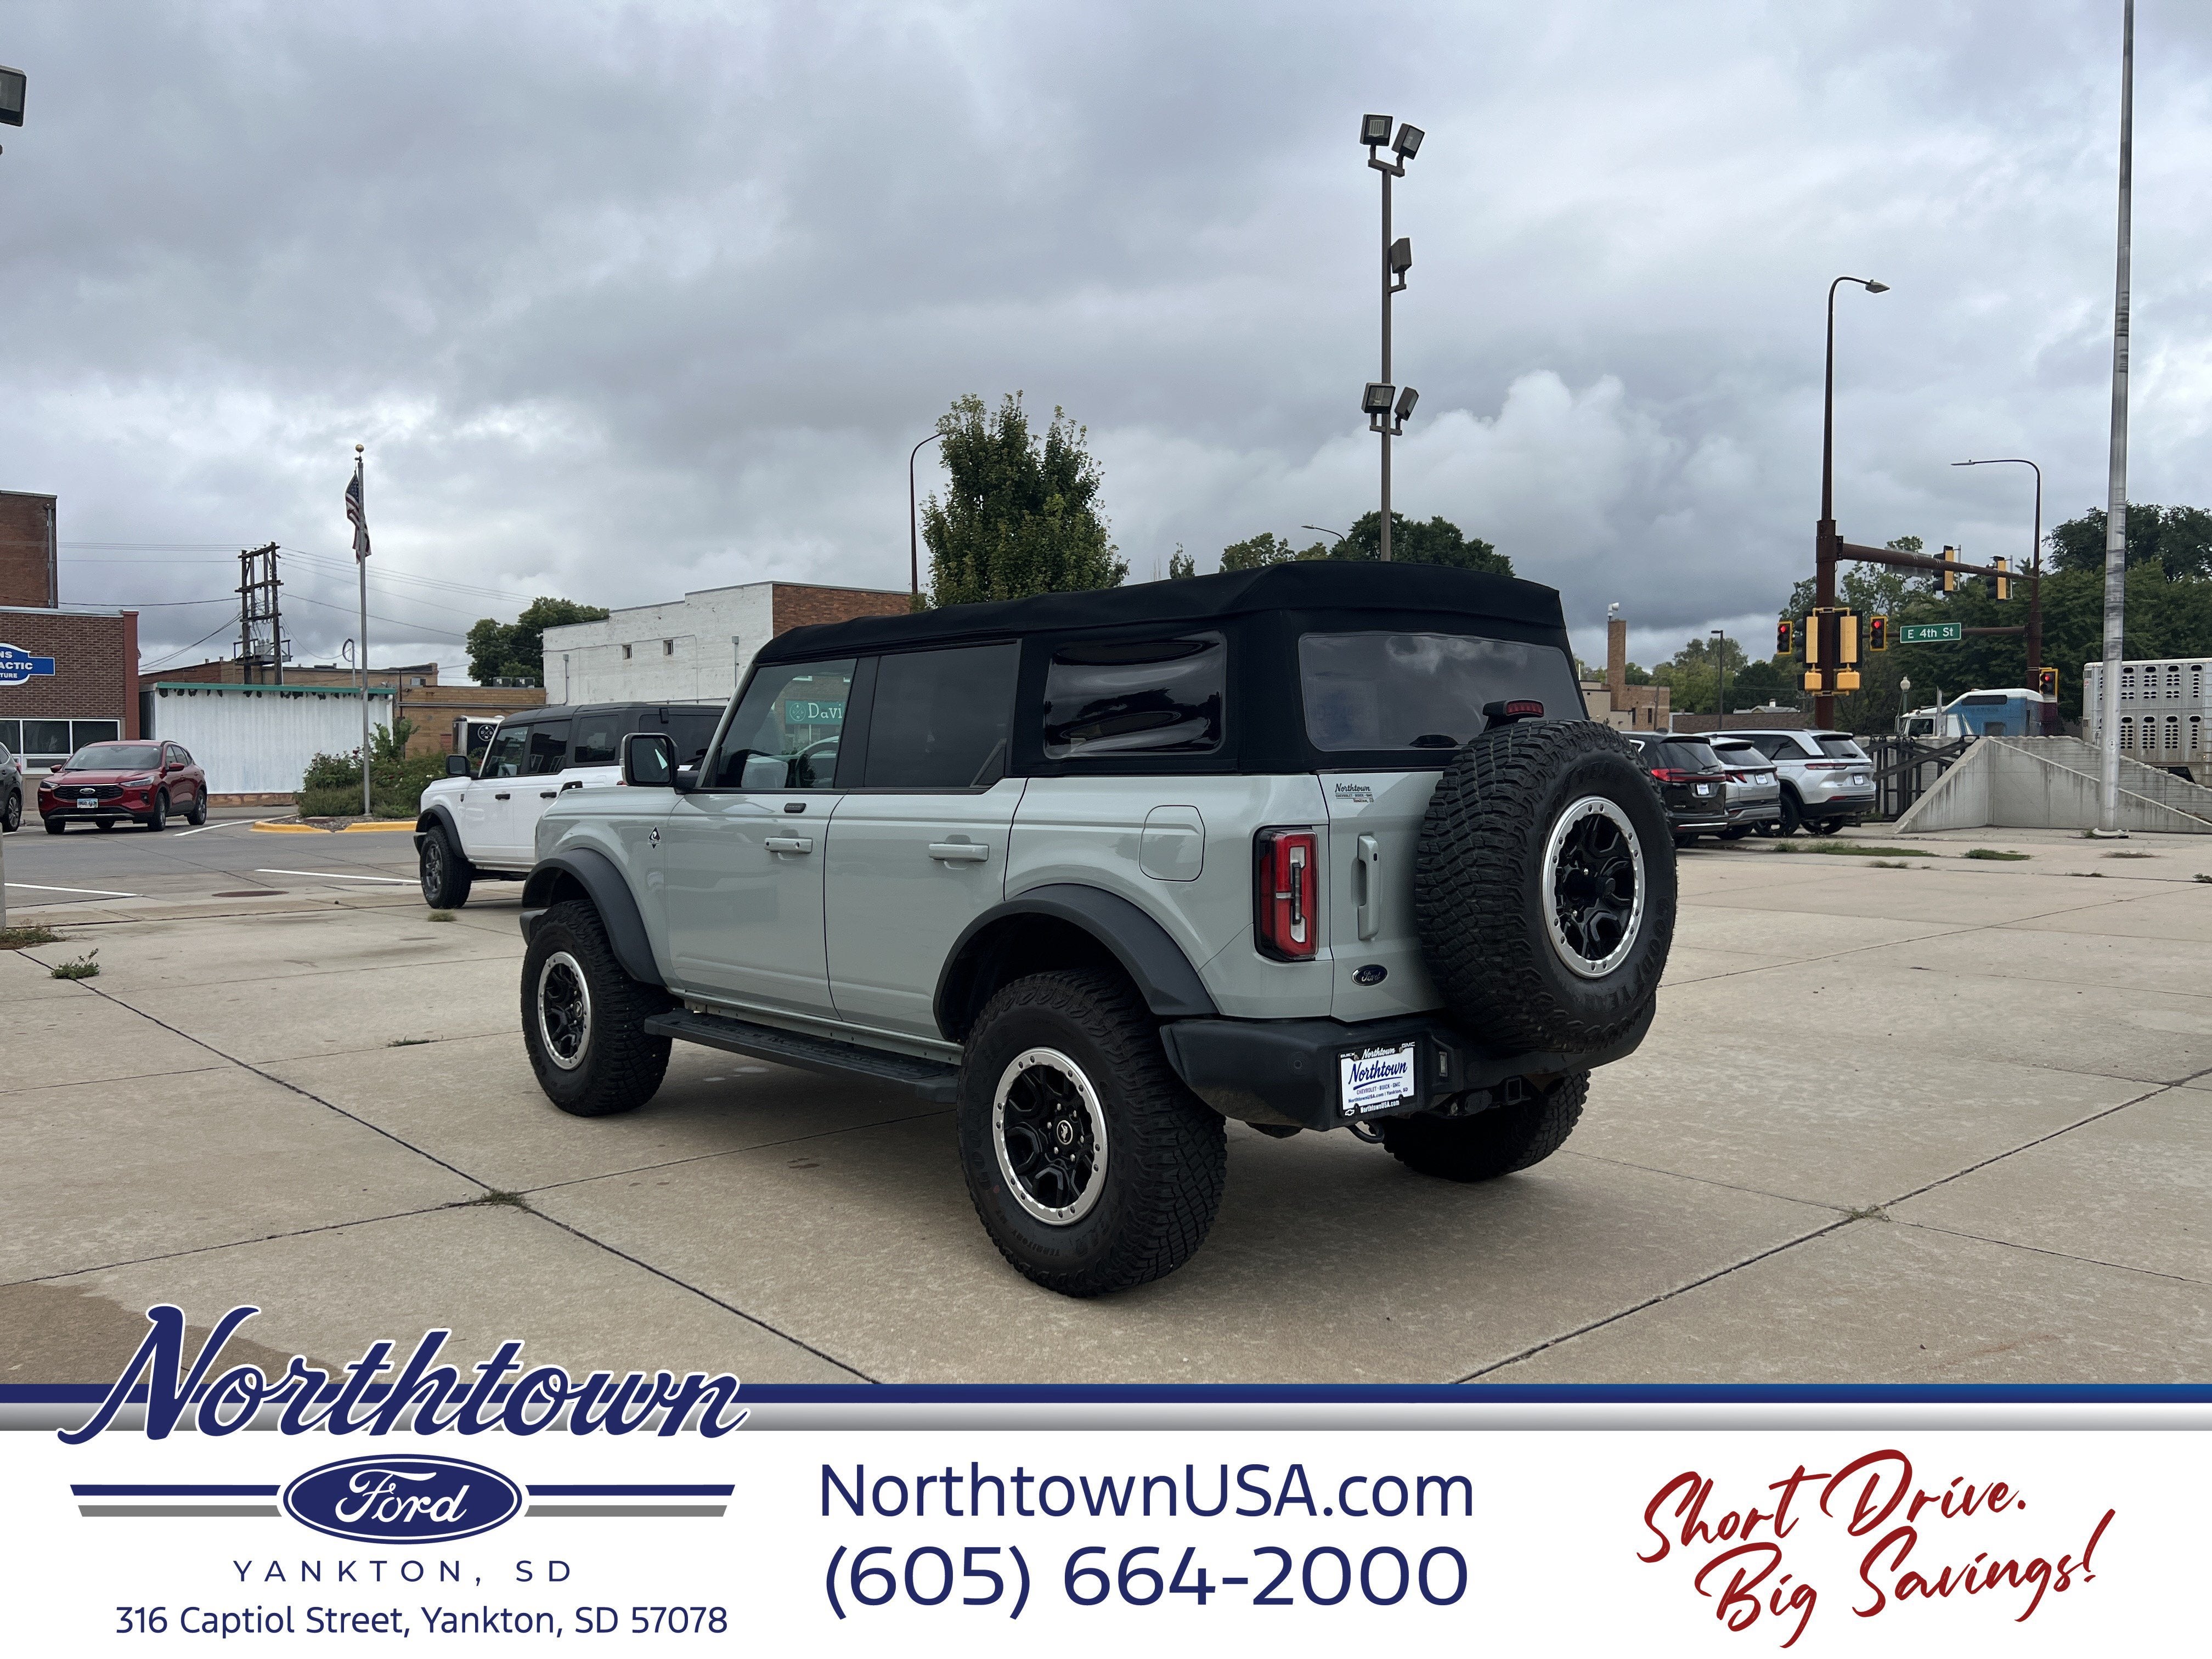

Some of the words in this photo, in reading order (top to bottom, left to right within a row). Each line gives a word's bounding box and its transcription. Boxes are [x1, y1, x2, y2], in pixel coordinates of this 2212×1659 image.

[1908, 629, 1914, 639] E
[1920, 628, 1937, 637] 4th
[1943, 627, 1953, 637] St
[808, 703, 843, 719] Davi
[1335, 783, 1371, 792] Northtown
[1361, 969, 1381, 982] Ford
[1361, 1047, 1396, 1060] Northtown
[1347, 1060, 1408, 1085] Northtown
[1356, 1086, 1377, 1095] CHEVROLET
[1360, 1100, 1400, 1114] NorthtownUSA.com
